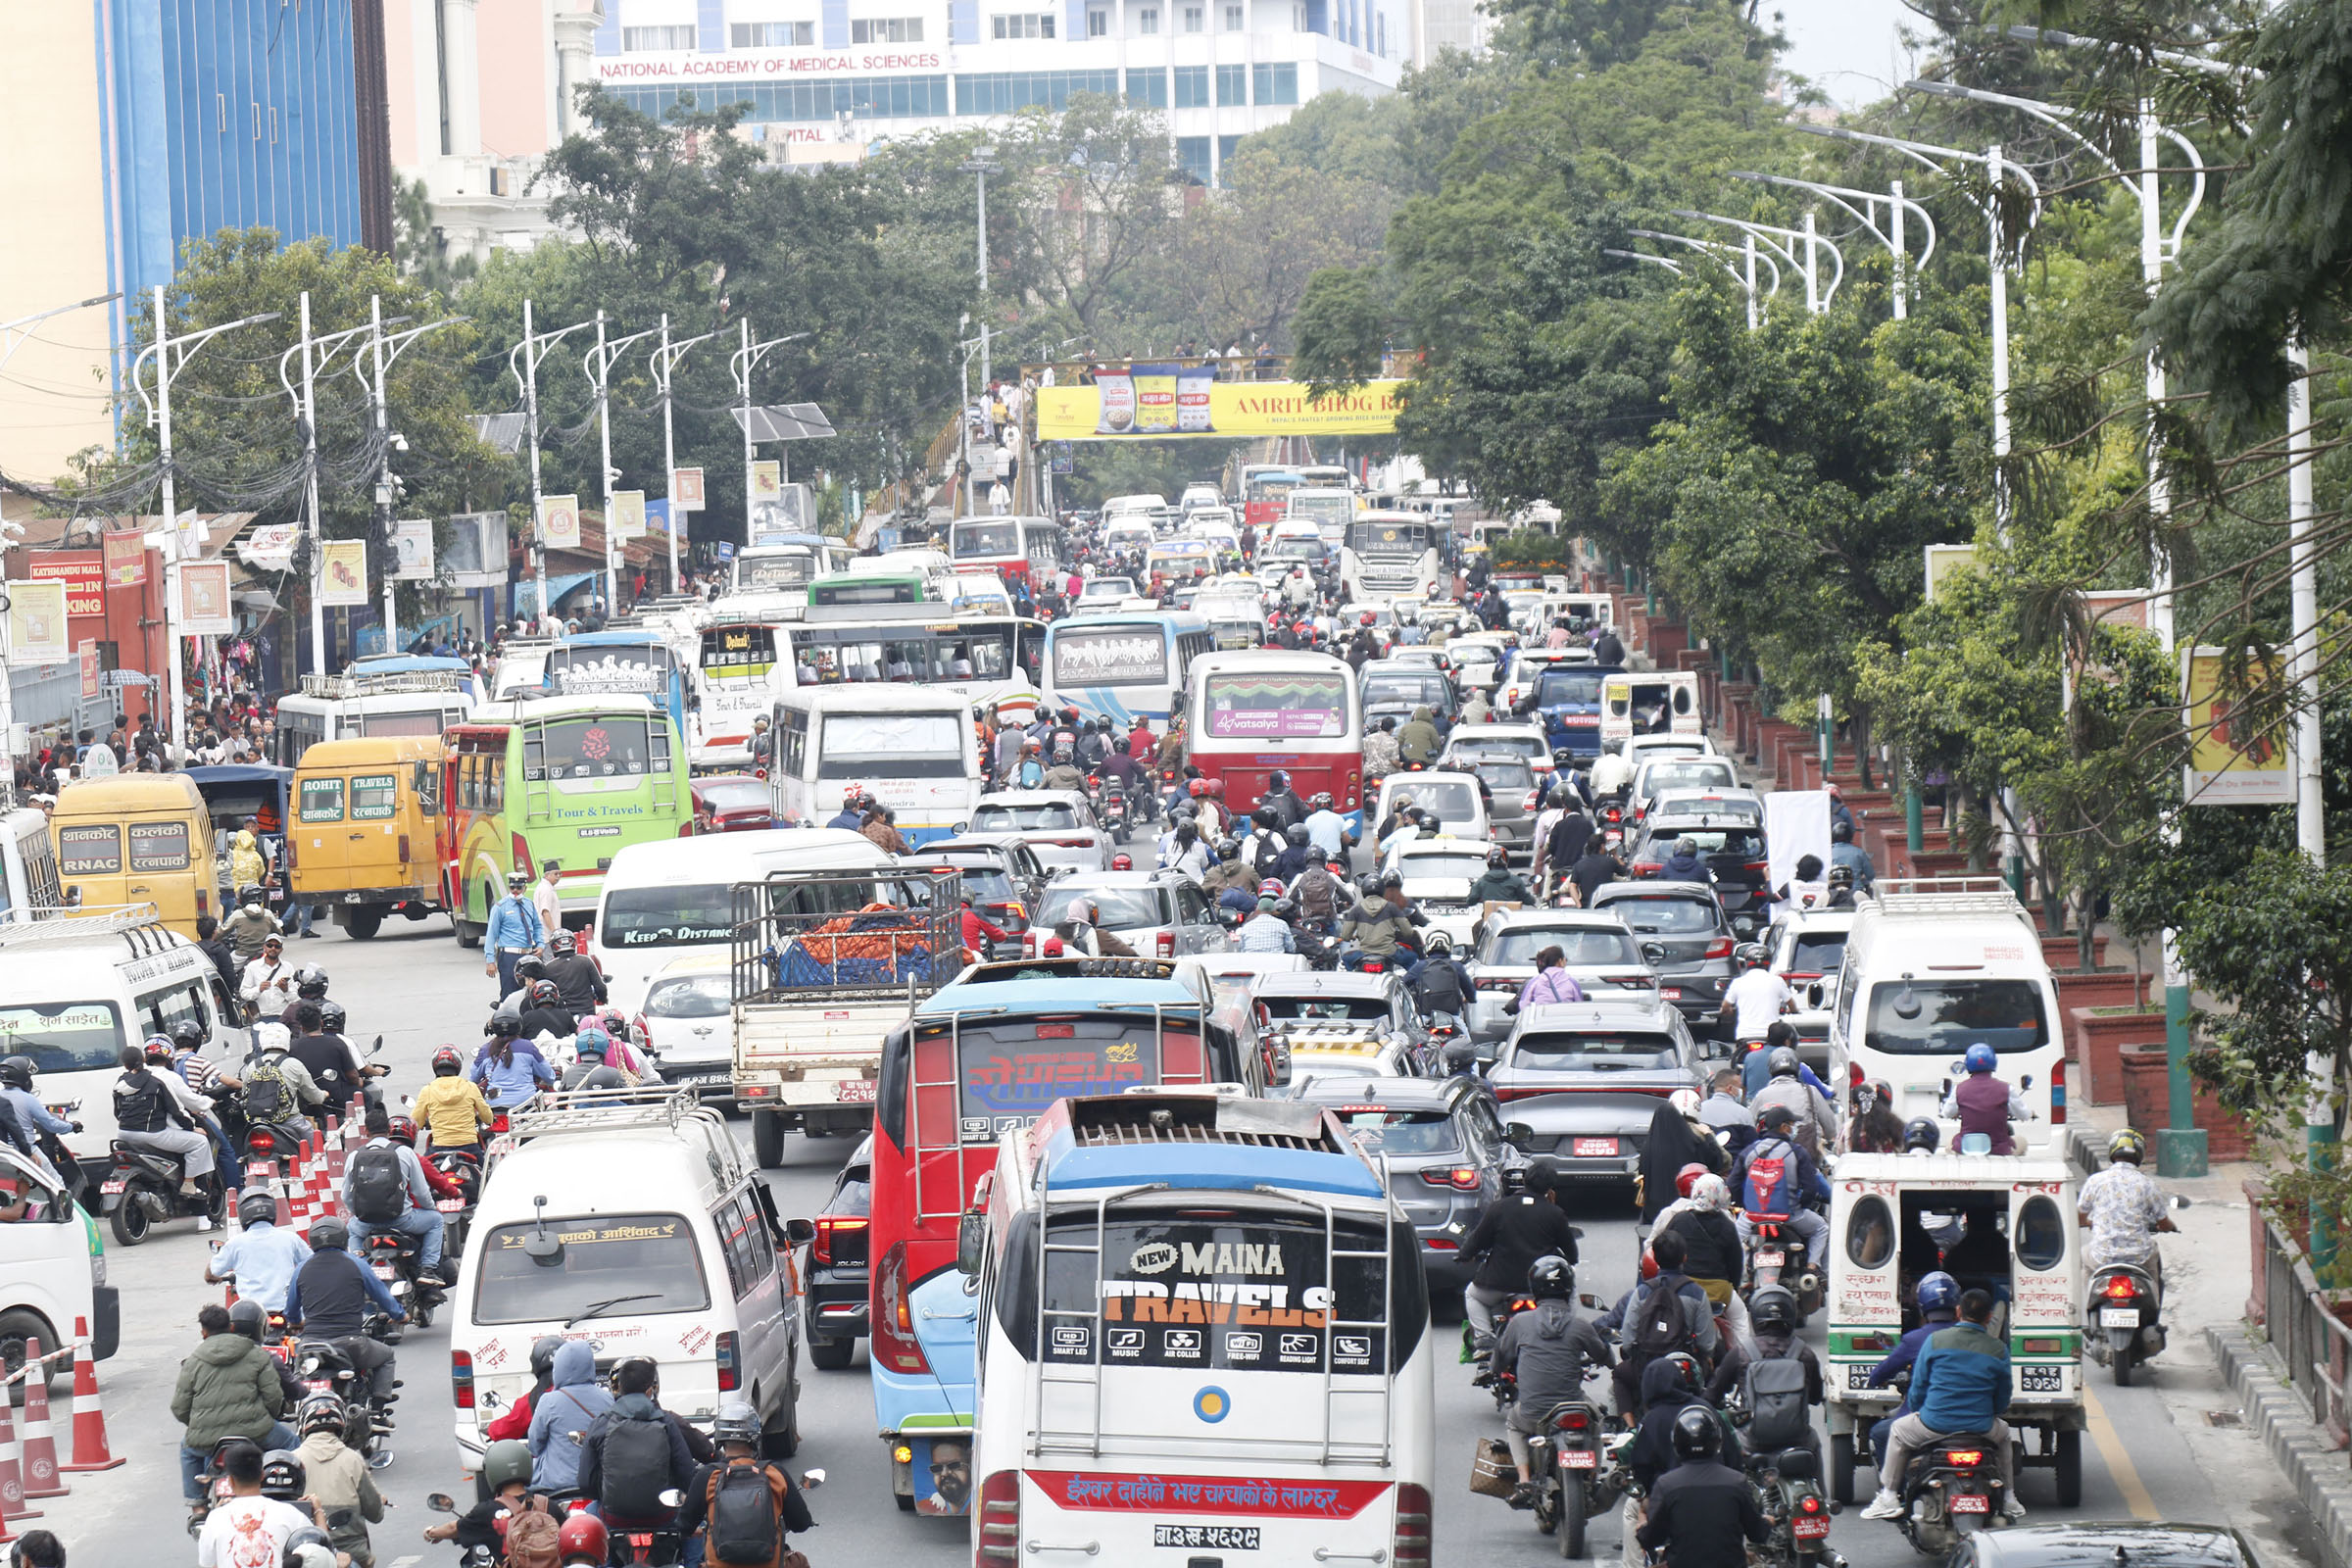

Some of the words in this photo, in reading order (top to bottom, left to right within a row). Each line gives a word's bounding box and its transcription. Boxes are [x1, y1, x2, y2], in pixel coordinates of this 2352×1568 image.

[601, 62, 677, 77] NATIONAL
[683, 60, 760, 75] ACADEMY
[764, 59, 785, 73] OF
[790, 57, 857, 73] MEDICAL
[862, 54, 940, 70] SCIENCES
[1236, 397, 1306, 414] AMRIT
[1313, 394, 1373, 413] BHOG
[32, 565, 80, 577] KATHMANDU
[81, 564, 102, 574] MALL
[85, 580, 102, 593] IN
[1234, 718, 1279, 731] vatsalya
[303, 779, 342, 792] ROHIT
[354, 777, 393, 788] TRAVELS
[302, 808, 341, 820] थानकोट
[354, 805, 393, 819] रत्नपार्क
[556, 808, 585, 819] Tour
[588, 807, 598, 817] &
[600, 804, 644, 816] Travels
[63, 827, 117, 842] थानकोट
[131, 824, 185, 838] कलंकी
[64, 858, 119, 872] RNAC
[133, 854, 186, 868] रत्नपार्क
[1137, 1249, 1171, 1268] NEW
[1181, 1242, 1284, 1275] MAINA
[1096, 1280, 1338, 1328] TRAVELS
[1280, 1354, 1300, 1363] READING
[1301, 1355, 1317, 1364] LIGHT
